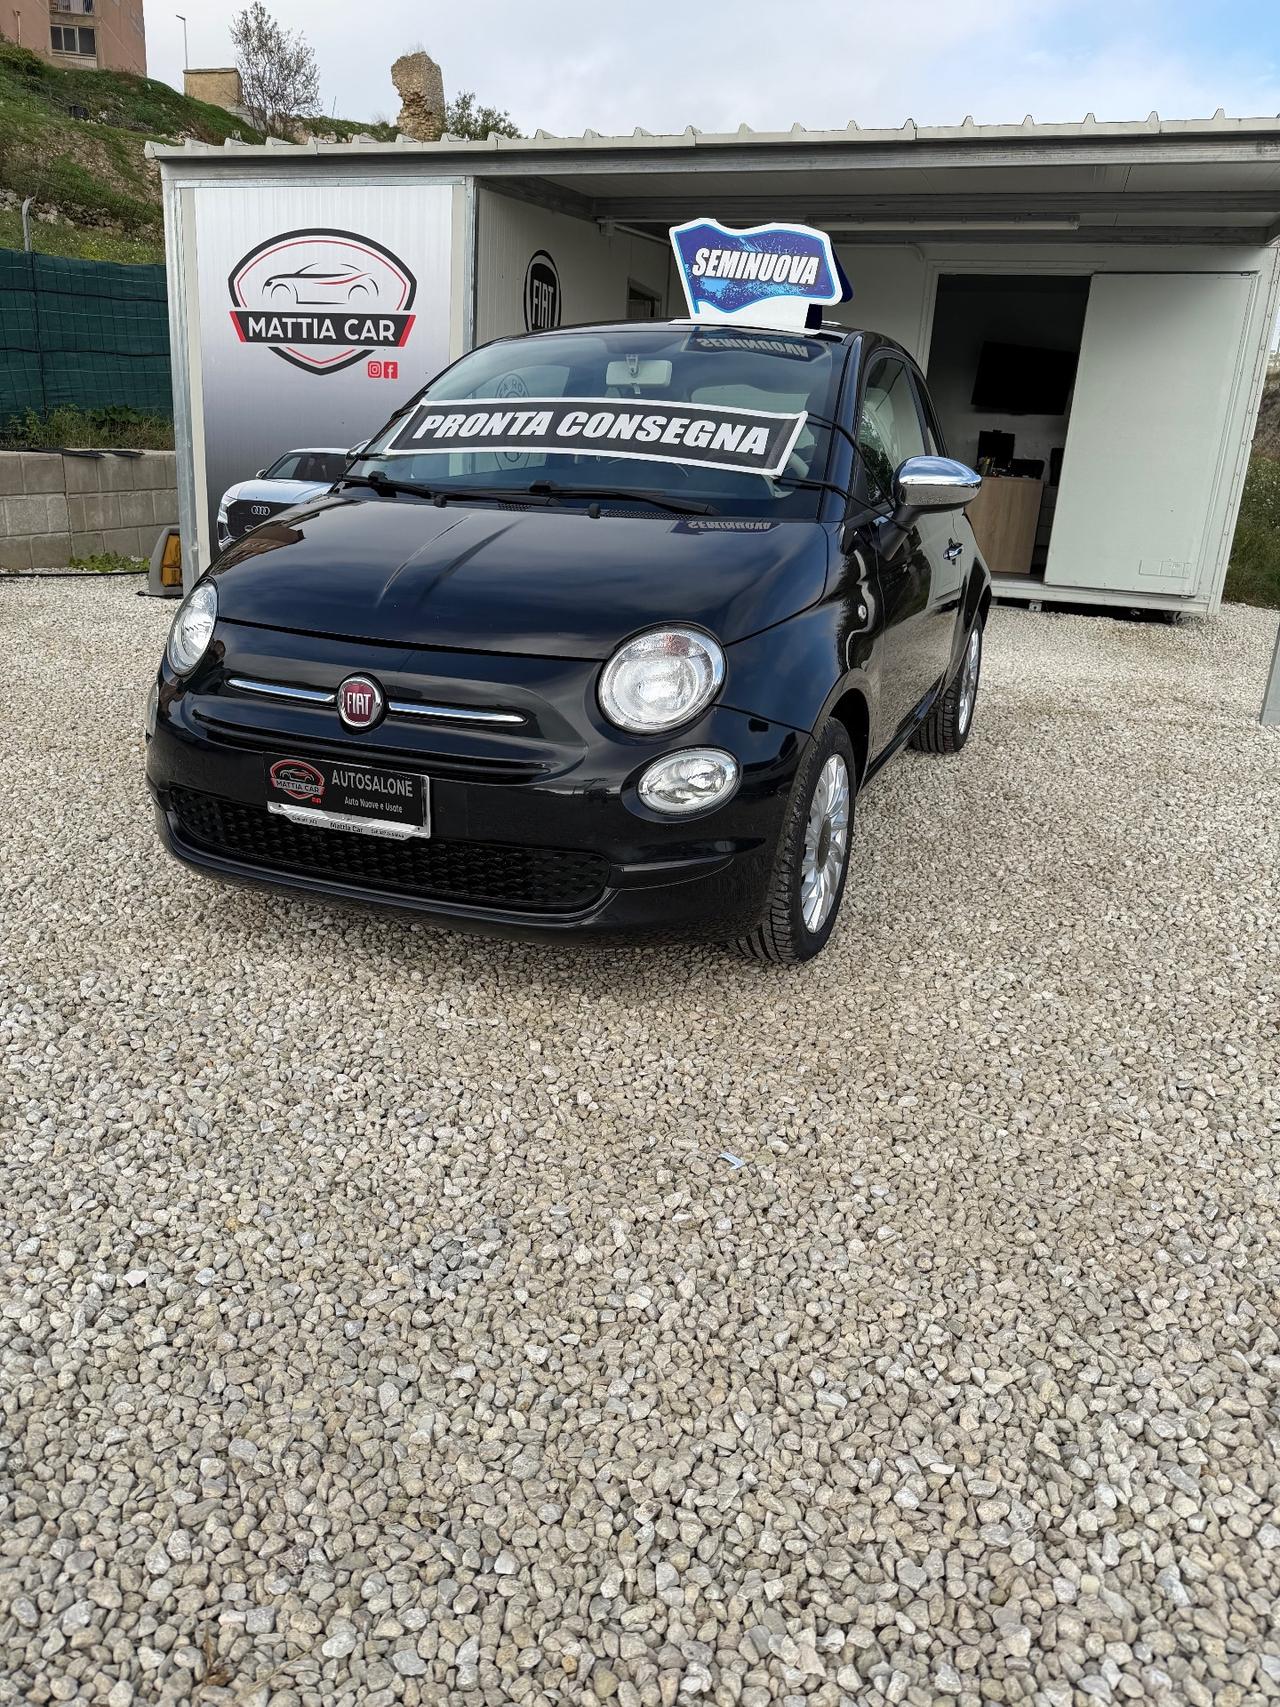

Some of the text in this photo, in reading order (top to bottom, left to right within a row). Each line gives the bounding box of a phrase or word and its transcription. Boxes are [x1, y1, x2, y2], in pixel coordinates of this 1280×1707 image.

[692, 247, 820, 285] SEMINUOVA
[532, 278, 554, 329] FIAT
[248, 316, 396, 342] MATTIA CAR
[412, 411, 770, 455] PRONTA CONSEGNA
[347, 692, 372, 715] FIAT
[275, 779, 320, 794] MATTIA CAR
[331, 769, 414, 798] AUTOSALONE
[344, 796, 359, 806] Auto
[352, 825, 363, 833] Car
